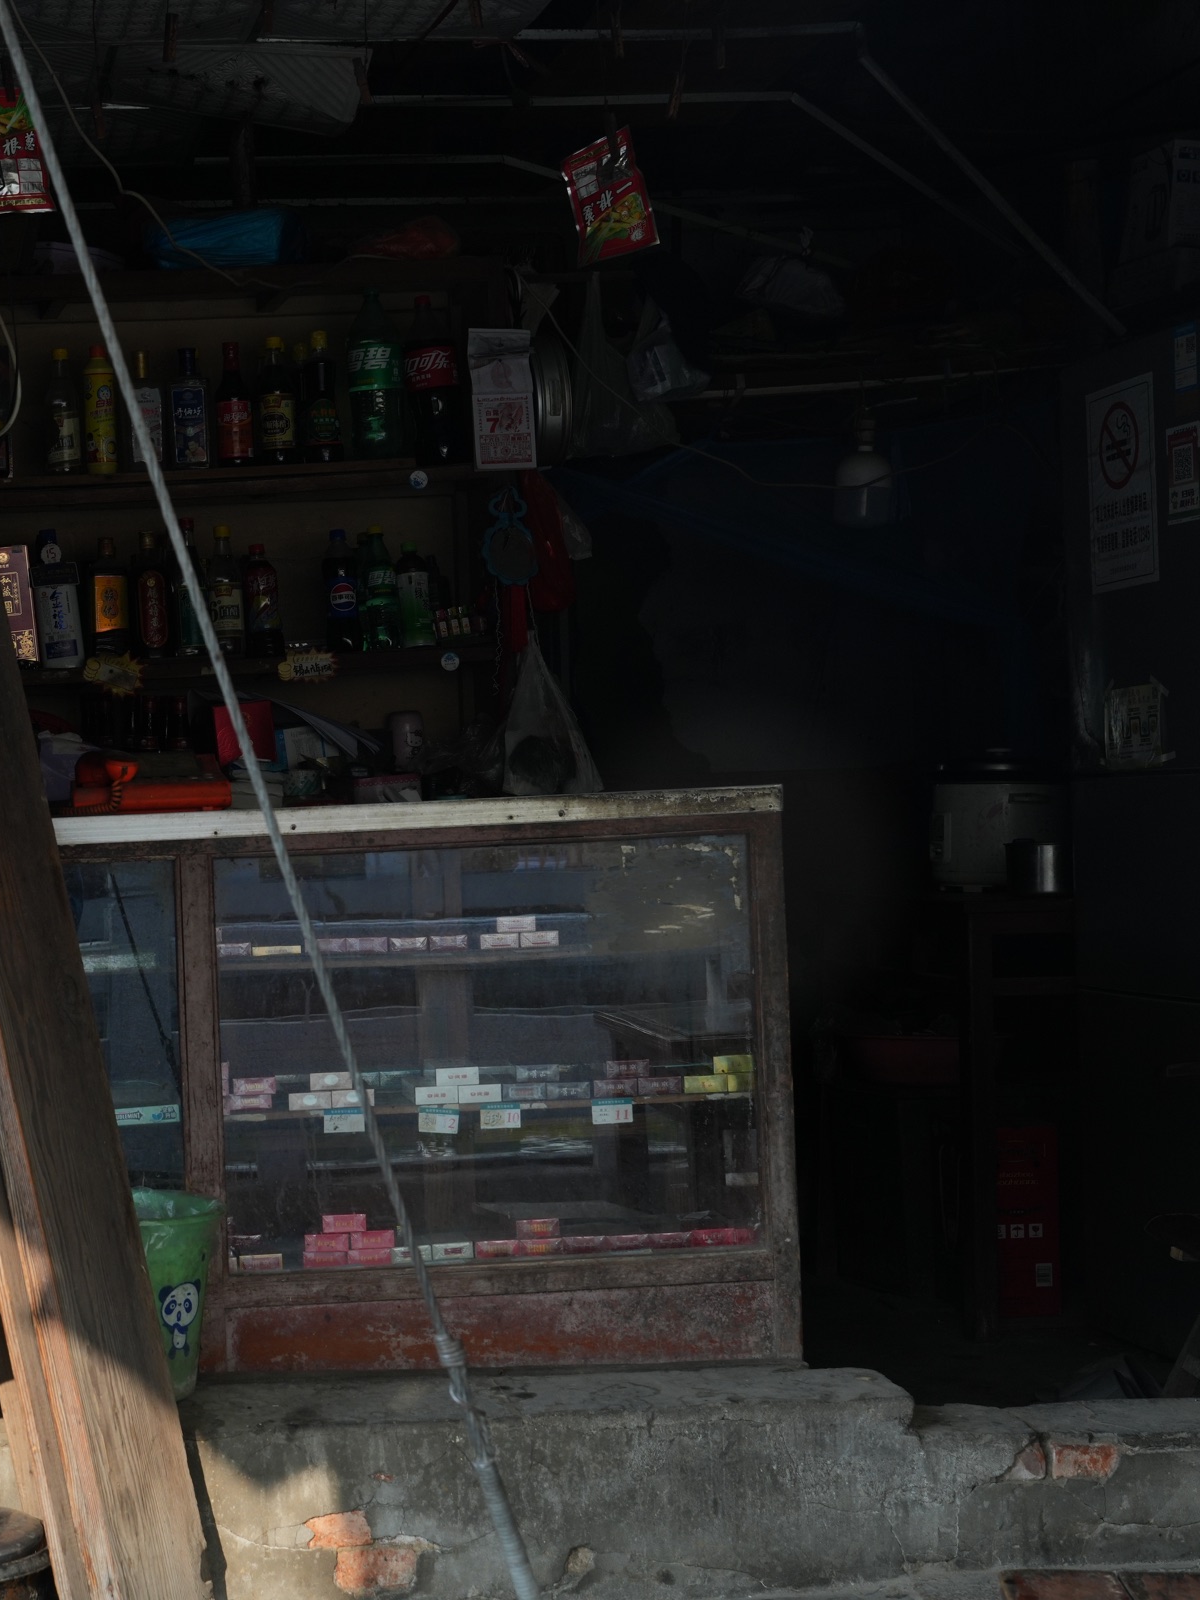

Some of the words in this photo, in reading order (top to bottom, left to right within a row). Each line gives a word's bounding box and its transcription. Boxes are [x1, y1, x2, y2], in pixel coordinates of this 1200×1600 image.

[347, 346, 392, 373] 雪碧
[486, 417, 500, 434] 7
[507, 1112, 520, 1123] 10
[614, 1109, 630, 1121] 11
